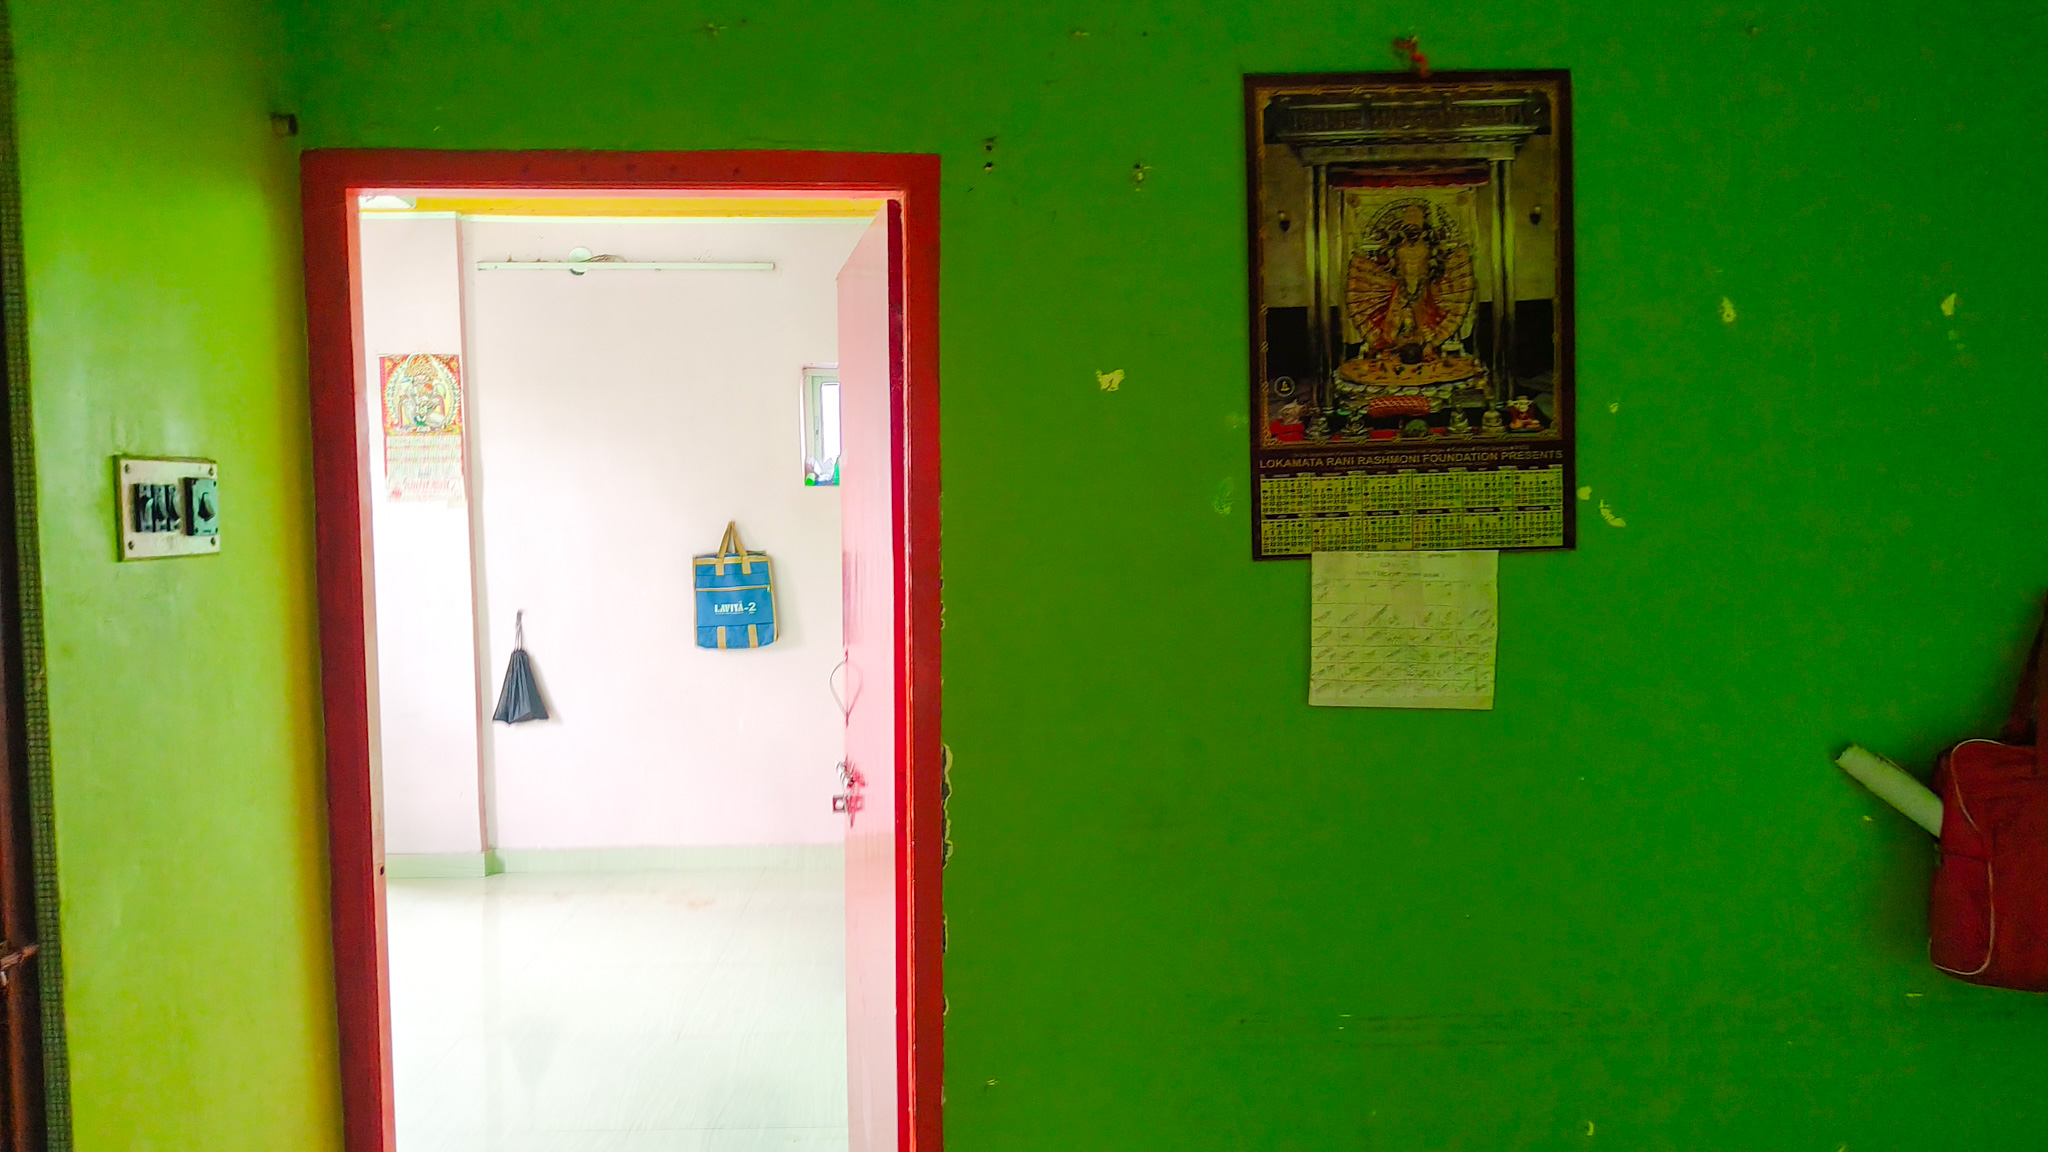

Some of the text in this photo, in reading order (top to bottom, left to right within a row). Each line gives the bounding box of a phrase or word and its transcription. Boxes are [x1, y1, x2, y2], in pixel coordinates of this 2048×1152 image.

[1259, 458, 1324, 469] LOKAMATA
[1326, 456, 1354, 466] RANI
[1357, 454, 1420, 465] RASHMONI
[1423, 451, 1498, 463] FOUNDATION
[1501, 450, 1563, 460] PRESENTS
